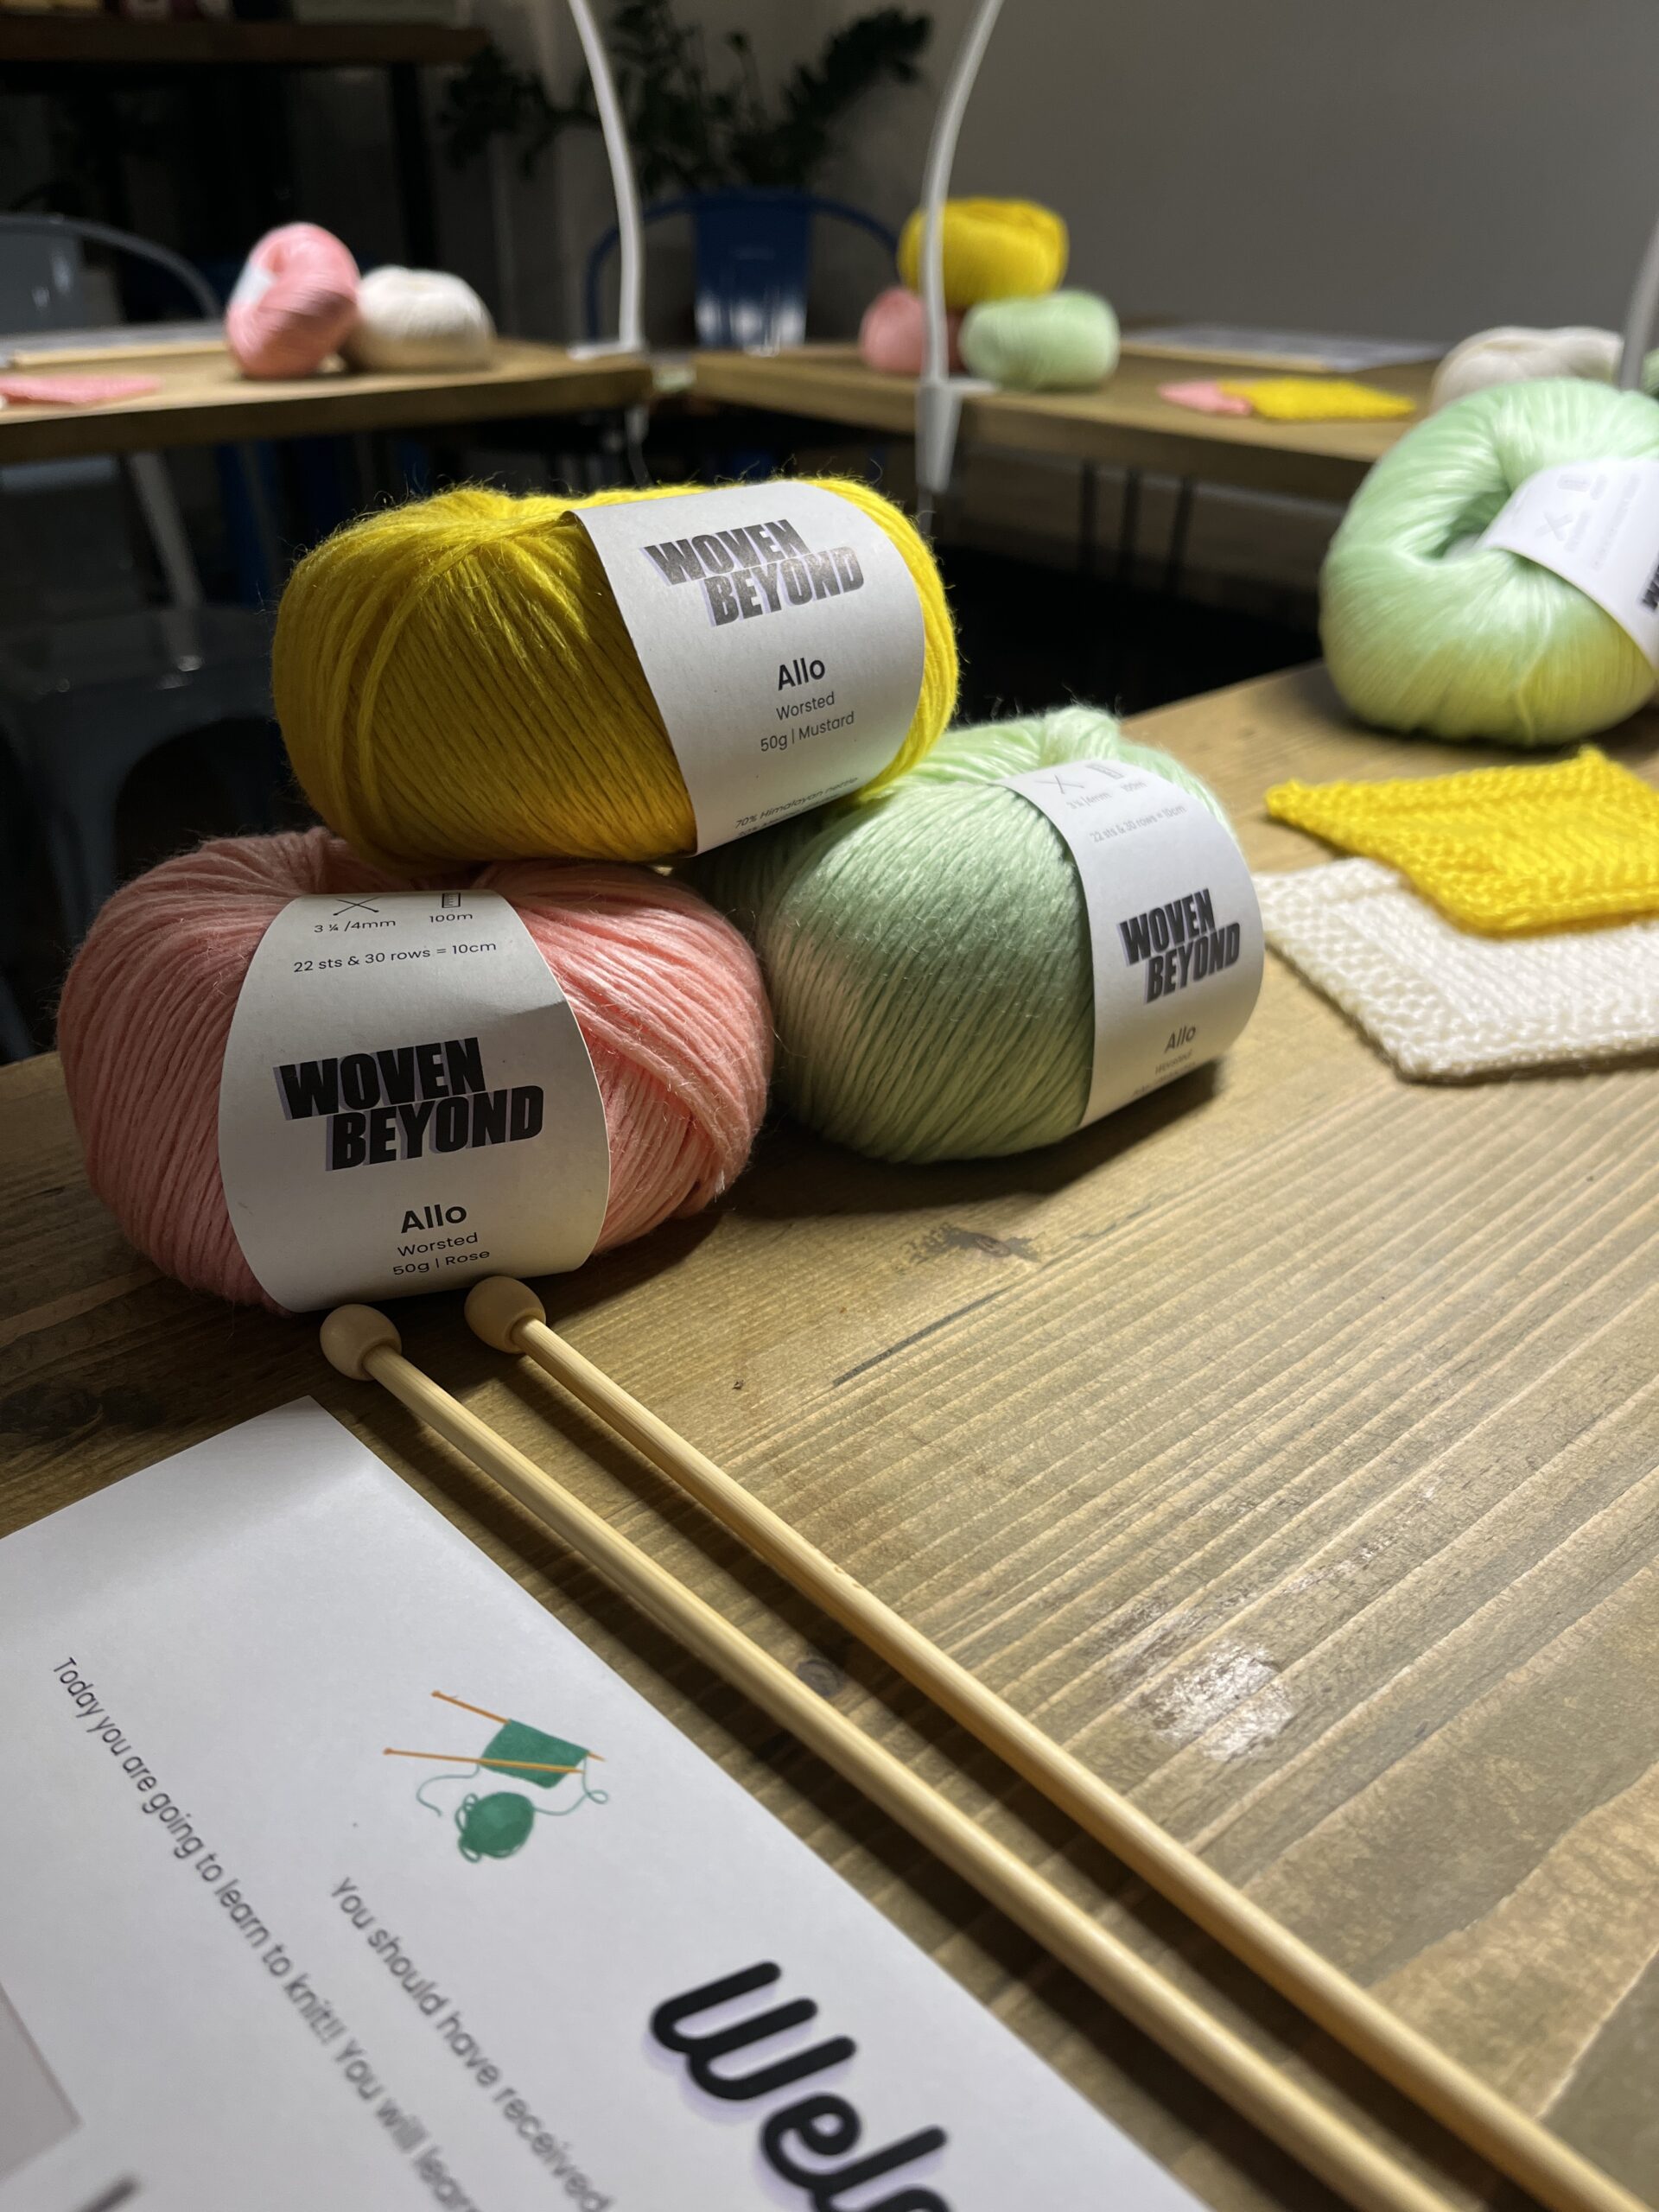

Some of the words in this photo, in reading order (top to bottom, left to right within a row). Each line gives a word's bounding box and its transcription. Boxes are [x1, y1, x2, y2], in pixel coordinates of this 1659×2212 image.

[639, 519, 810, 586] WOVEN
[699, 546, 864, 626] BEYOND
[779, 658, 825, 691] Allo
[776, 691, 835, 721] Worsted
[760, 734, 788, 752] 50g
[798, 710, 855, 741] Mustard
[734, 815, 758, 829] 70%
[429, 912, 474, 923] 100m
[1116, 887, 1215, 967] WOVEN
[294, 961, 314, 973] 22
[318, 959, 342, 969] sts
[347, 957, 360, 966] &
[365, 952, 385, 964] 30
[391, 949, 431, 961] rows
[452, 943, 497, 954] 10cm
[1143, 922, 1241, 1004] BEYOND
[1163, 1025, 1196, 1053] Allo
[273, 1037, 486, 1121] WOVEN
[326, 1085, 544, 1172] BEYOND
[401, 1205, 467, 1233] Allo
[393, 1263, 429, 1274] 50g
[445, 1251, 490, 1265] Rose
[397, 1232, 478, 1256] Worsted
[53, 1656, 105, 1719] Today
[86, 1715, 131, 1756] you
[122, 1756, 157, 1792] are
[142, 1792, 205, 1859] going
[195, 1853, 224, 1882] to
[214, 1878, 271, 1948] learn
[261, 1942, 293, 1977] to
[335, 2038, 384, 2101] You
[331, 1877, 374, 1929] You
[367, 1929, 449, 2016] should
[435, 2011, 500, 2087] have
